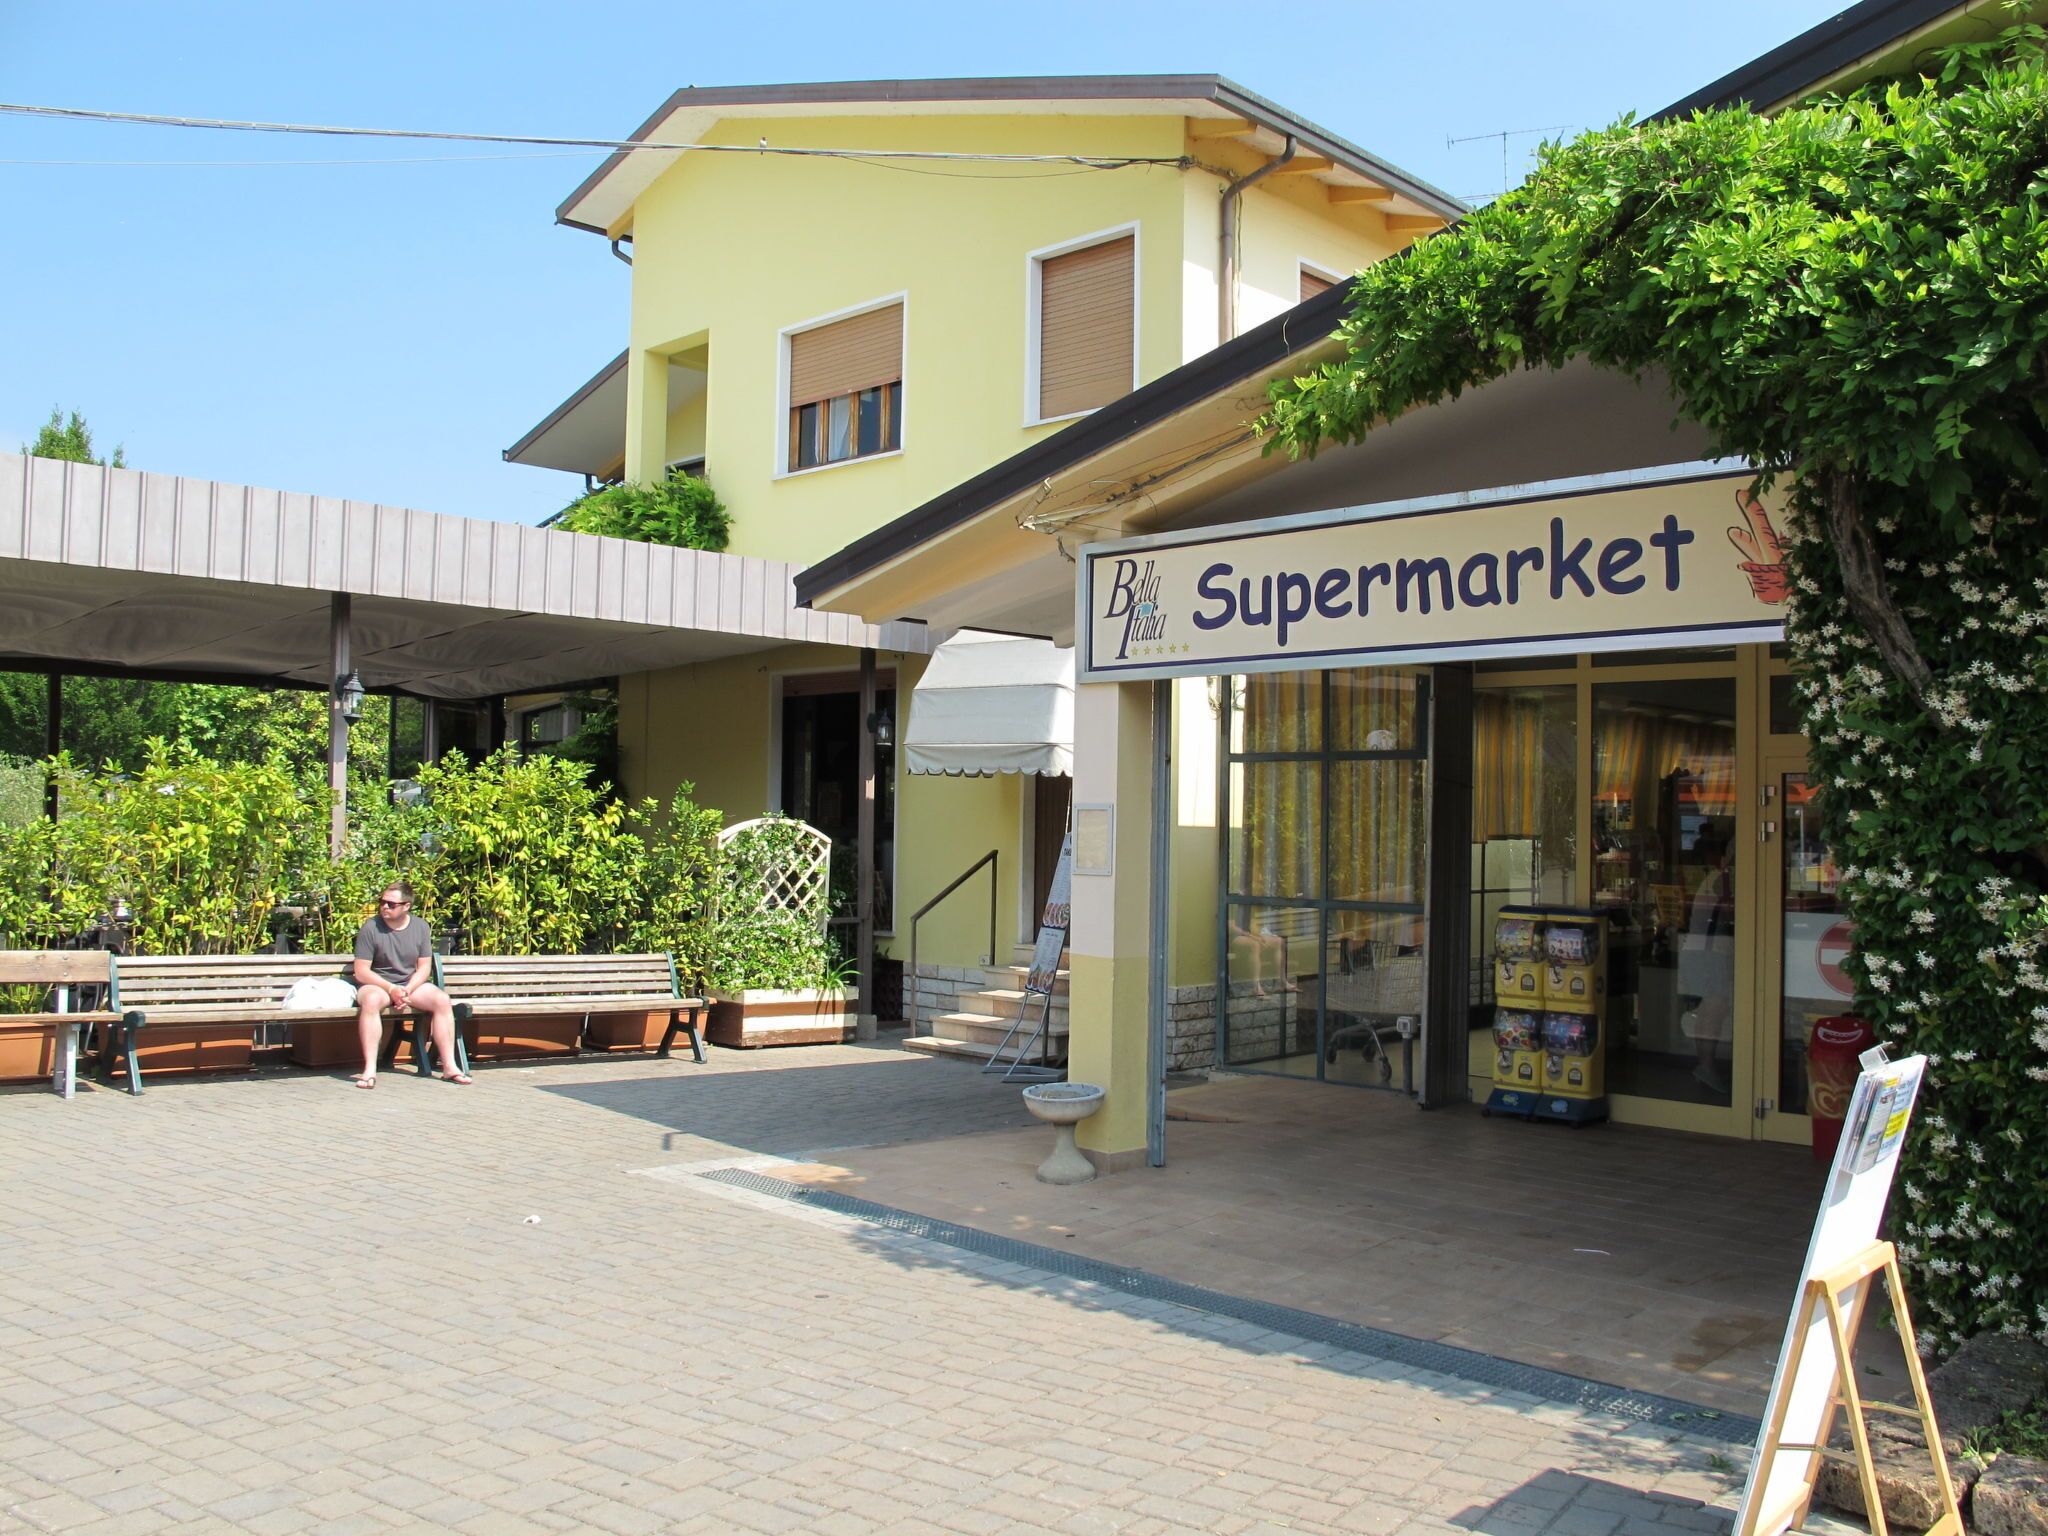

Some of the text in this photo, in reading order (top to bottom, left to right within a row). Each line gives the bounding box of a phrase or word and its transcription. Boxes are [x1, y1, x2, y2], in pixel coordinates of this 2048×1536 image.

[1103, 558, 1162, 619] Bella
[1192, 514, 1695, 647] Supermarket
[1115, 601, 1168, 660] Italia
